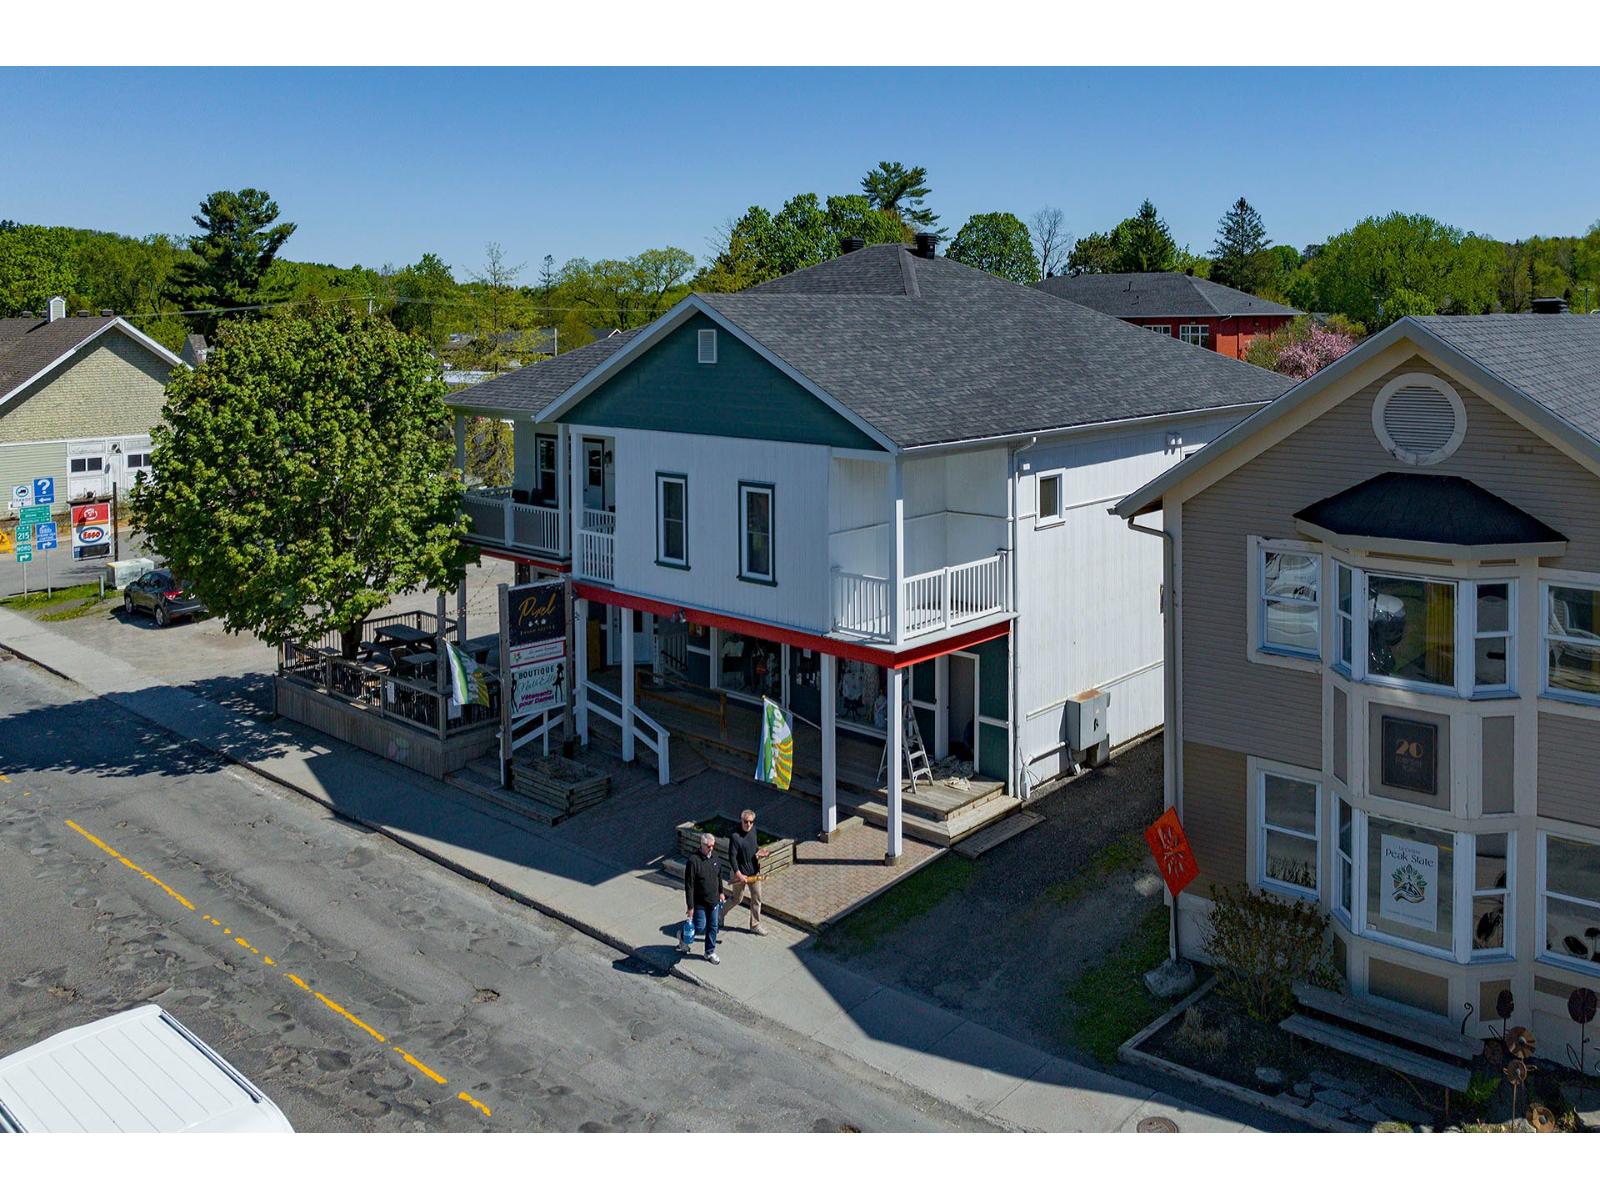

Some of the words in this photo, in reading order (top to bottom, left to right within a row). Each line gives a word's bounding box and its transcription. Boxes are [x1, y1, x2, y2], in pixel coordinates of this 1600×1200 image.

[17, 532, 30, 540] 215
[83, 531, 101, 541] Esso
[518, 665, 555, 680] BOUTIQUE
[1384, 848, 1408, 862] Peak
[1411, 854, 1434, 868] State
